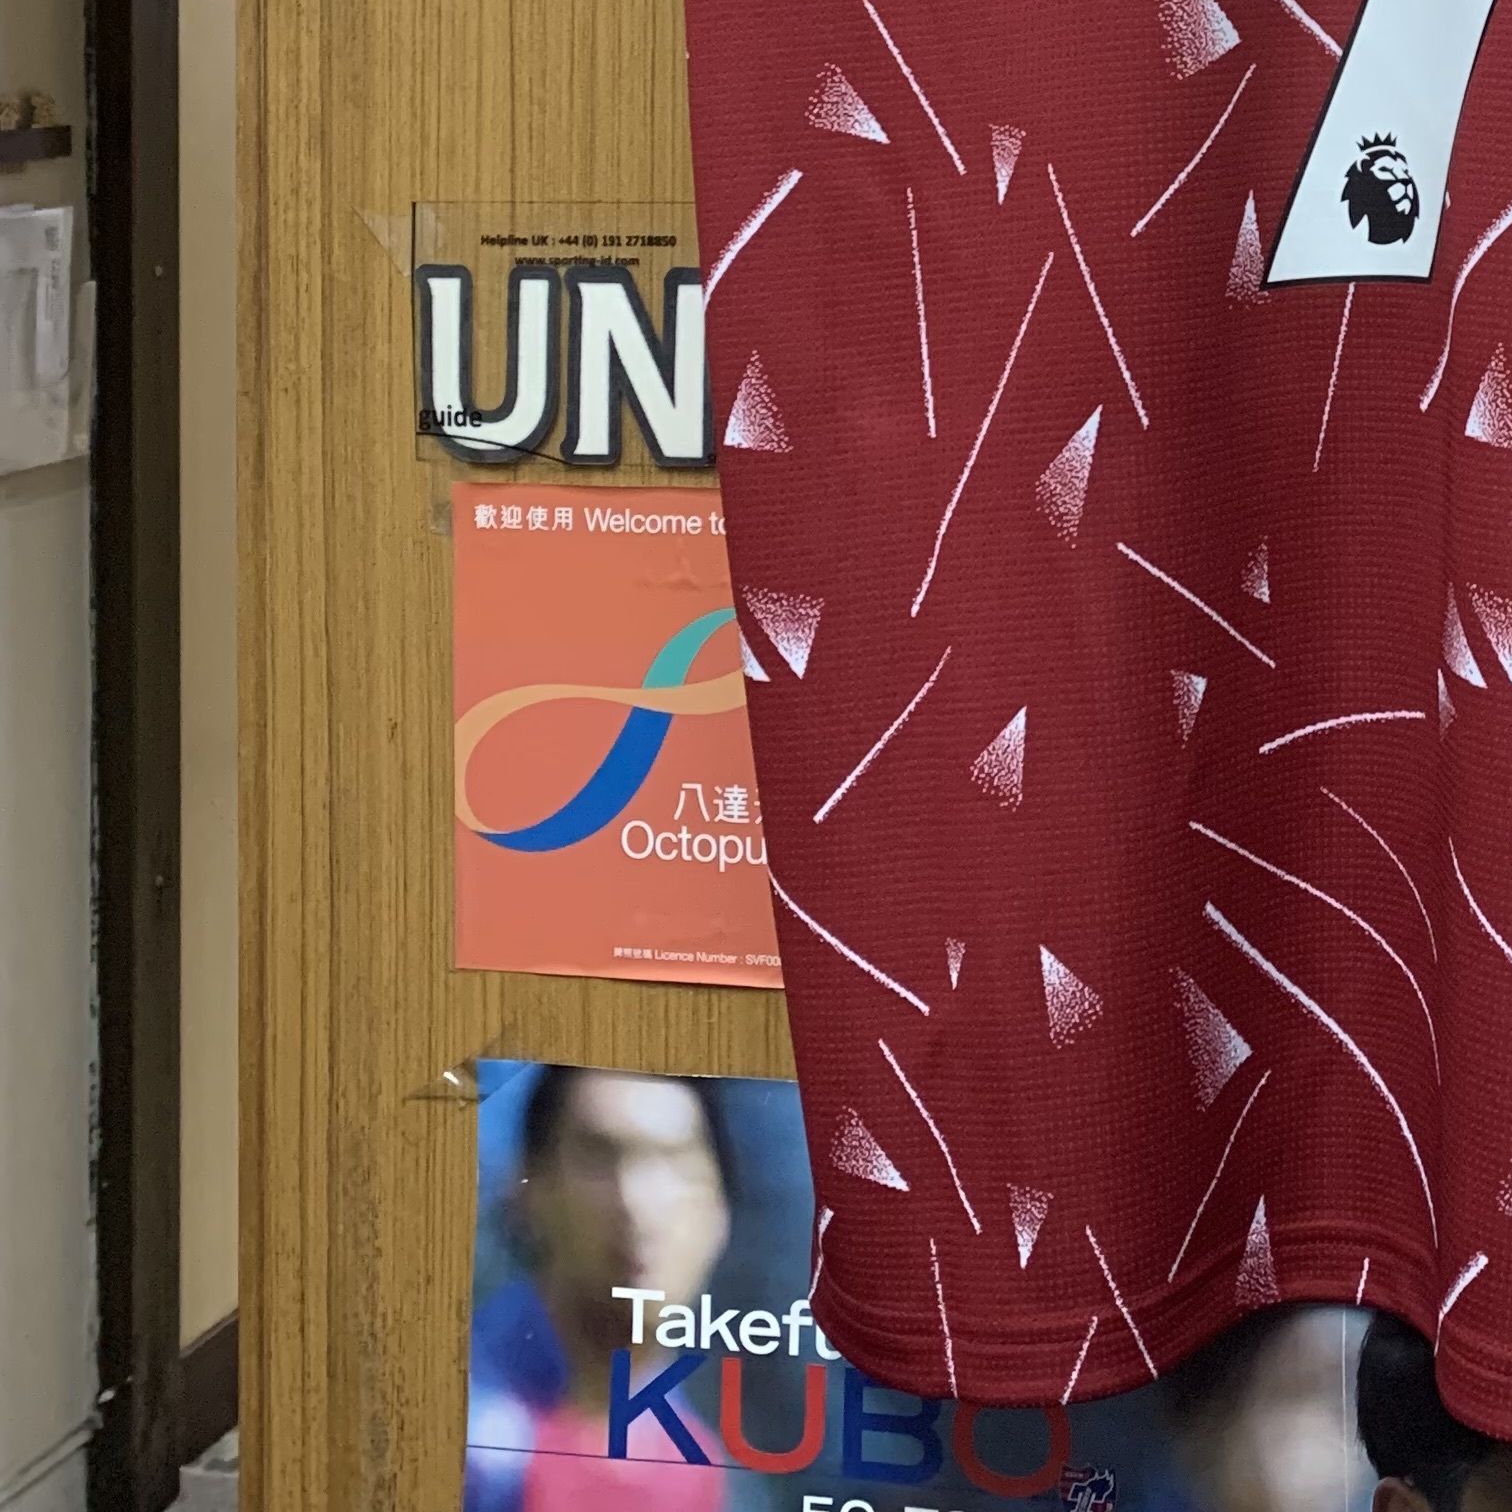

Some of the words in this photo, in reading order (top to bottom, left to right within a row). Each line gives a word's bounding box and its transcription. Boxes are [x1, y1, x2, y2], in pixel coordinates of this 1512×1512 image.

[480, 234, 528, 250] Helpline
[558, 235, 579, 247] +44
[582, 234, 598, 248] (0)
[602, 235, 621, 247] 191
[514, 255, 640, 267] www.sporting-id.com
[419, 404, 482, 431] guide
[473, 504, 574, 532] 歡迎使用
[583, 507, 702, 535] Welcome
[621, 820, 768, 873] Octopu
[654, 949, 695, 962] Licence
[696, 951, 738, 964] Number
[608, 1349, 1072, 1498] KUBO
